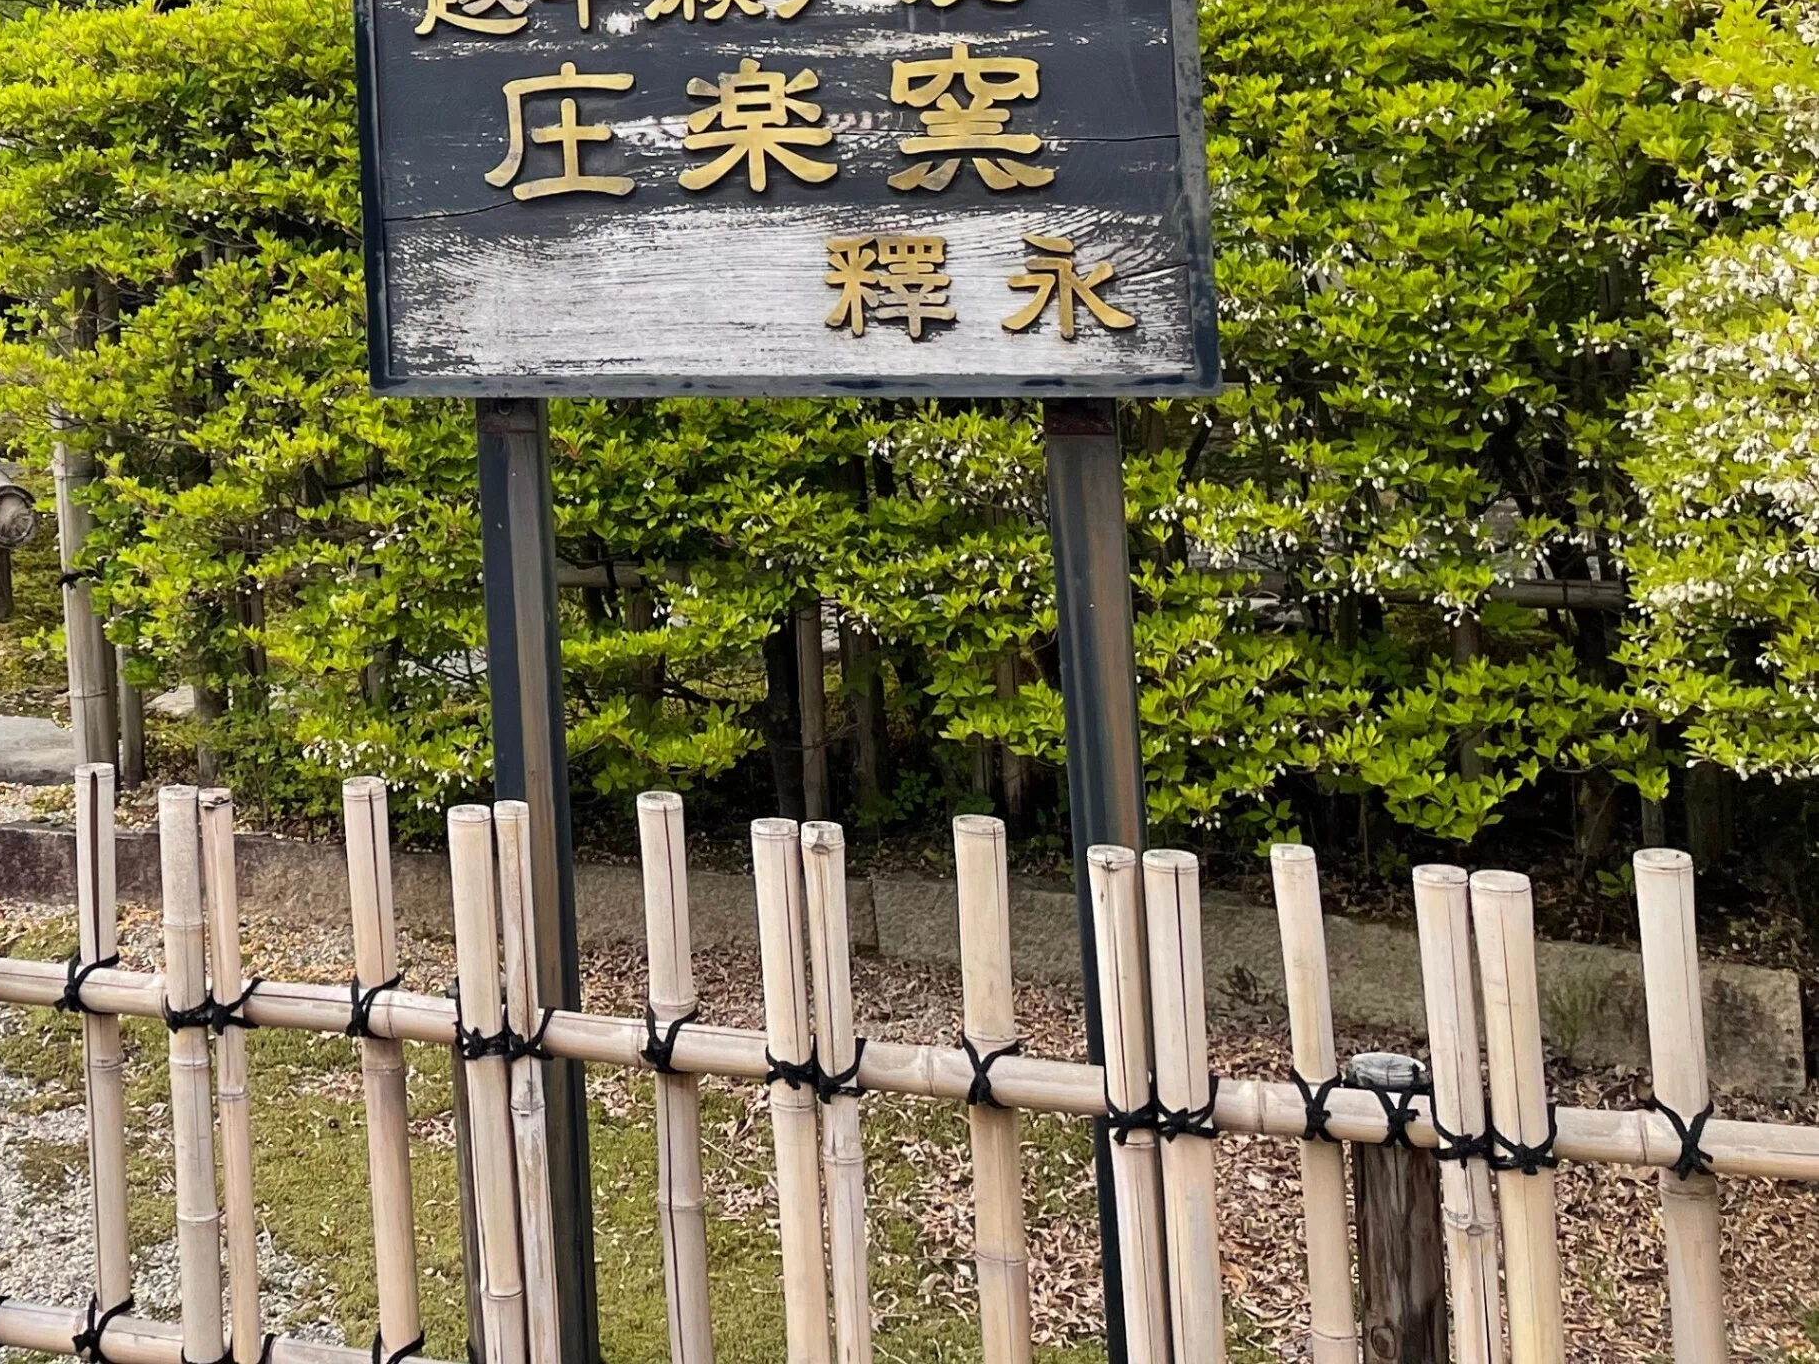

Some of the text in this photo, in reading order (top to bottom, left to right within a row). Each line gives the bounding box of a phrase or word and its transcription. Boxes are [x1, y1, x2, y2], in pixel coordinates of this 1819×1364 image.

[484, 43, 1055, 201] 庄楽窯
[824, 235, 1136, 340] 釋永
